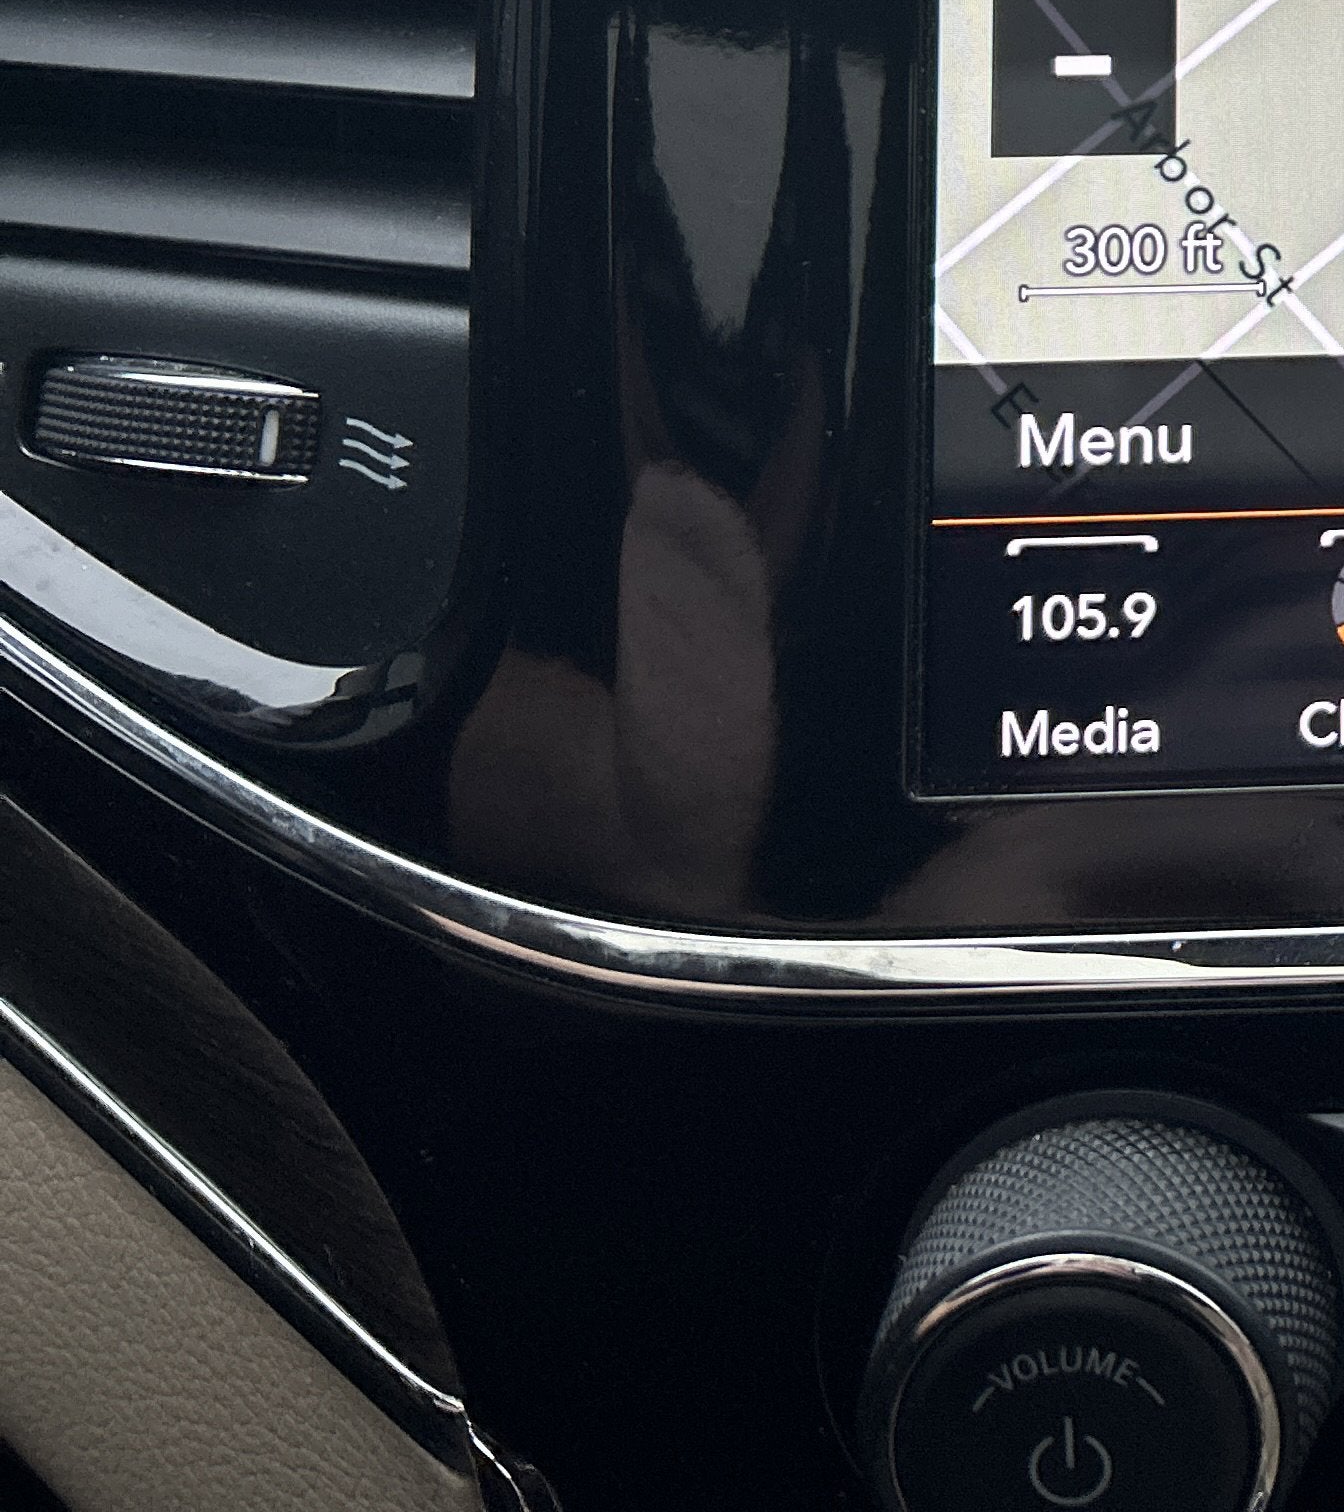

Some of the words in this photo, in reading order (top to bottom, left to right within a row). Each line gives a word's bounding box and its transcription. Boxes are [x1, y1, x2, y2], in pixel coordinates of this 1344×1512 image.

[1111, 100, 1235, 233] Arbor
[1240, 243, 1294, 306] St
[1063, 225, 1167, 277] 300
[1181, 221, 1224, 273] ft
[1018, 413, 1193, 469] Menu
[1010, 591, 1157, 642] 105.9
[1001, 706, 1160, 757] Media
[987, 1345, 1139, 1393] VOLUME
